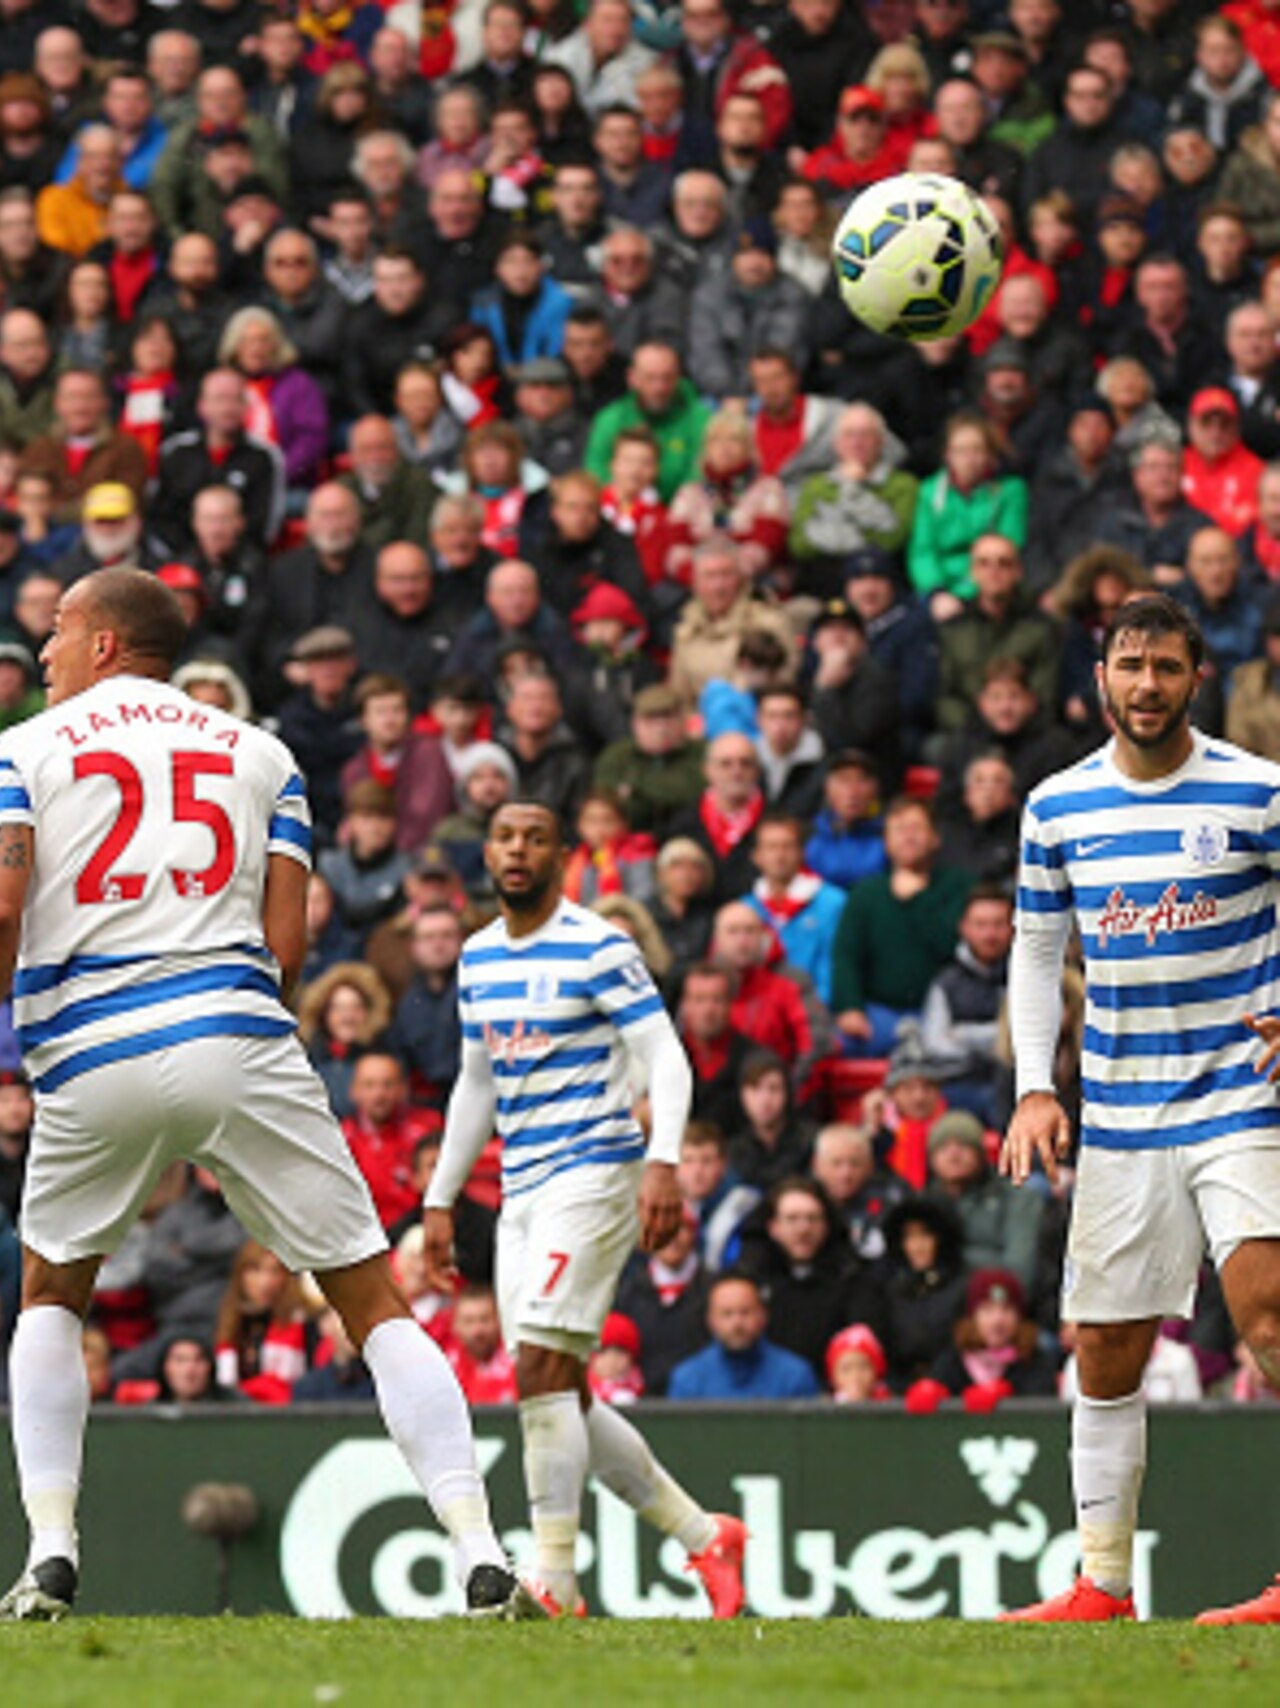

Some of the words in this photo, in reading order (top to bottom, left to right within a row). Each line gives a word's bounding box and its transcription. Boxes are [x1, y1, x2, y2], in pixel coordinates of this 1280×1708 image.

[54, 702, 242, 750] ZAMORA
[72, 749, 237, 905] 25
[1097, 882, 1218, 949] AirAsia
[543, 1252, 571, 1298] 7
